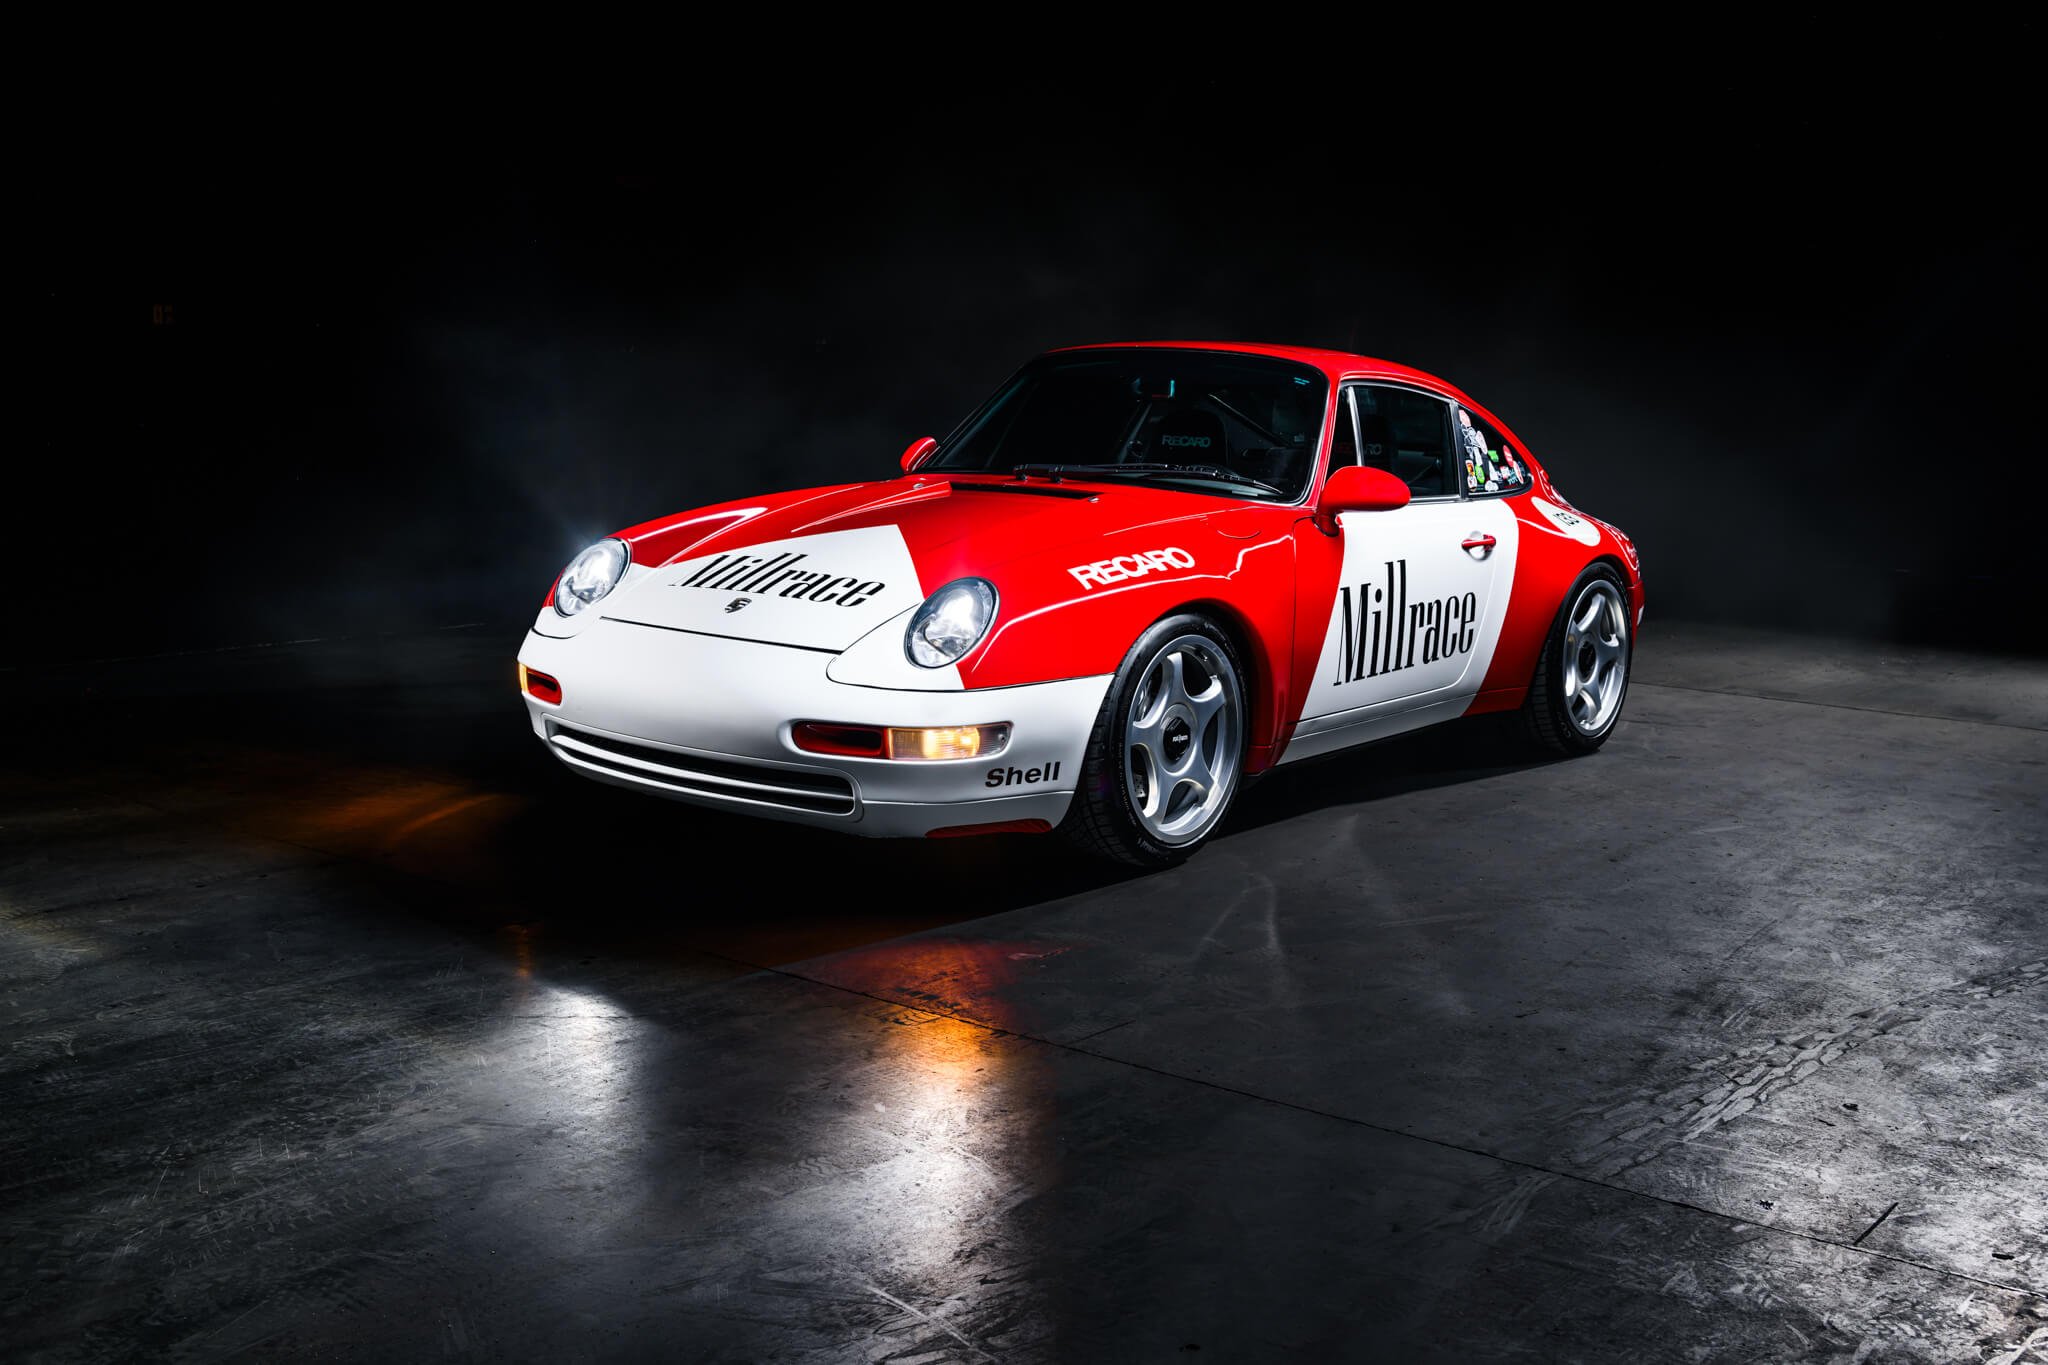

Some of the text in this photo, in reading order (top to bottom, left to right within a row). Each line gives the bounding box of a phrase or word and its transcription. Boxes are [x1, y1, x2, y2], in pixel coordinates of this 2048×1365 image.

[1162, 434, 1211, 448] RECARO
[668, 552, 886, 607] Millrace
[1067, 547, 1195, 590] RECARO
[1333, 559, 1476, 686] Millrace
[985, 761, 1061, 788] Shell
